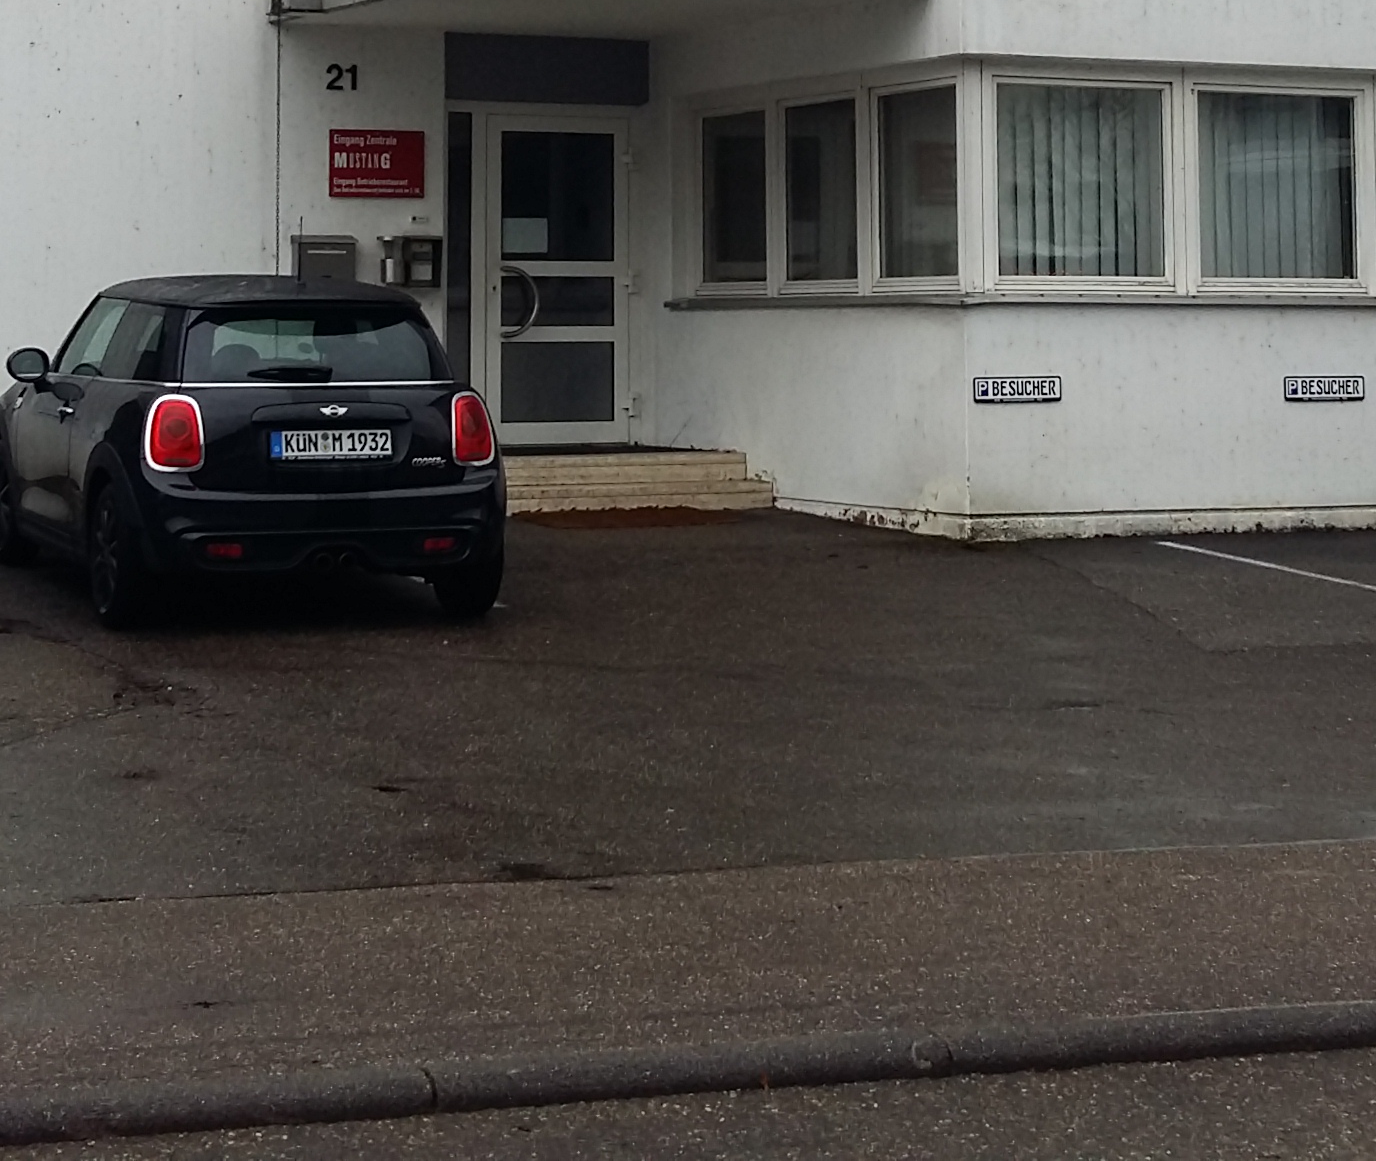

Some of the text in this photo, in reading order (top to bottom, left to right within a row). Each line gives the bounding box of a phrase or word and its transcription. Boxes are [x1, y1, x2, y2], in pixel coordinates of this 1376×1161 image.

[325, 63, 358, 90] 21
[333, 133, 397, 147] Eingang Zentrale
[992, 380, 1056, 397] BESUCHER
[1300, 379, 1360, 395] BESUCHER
[284, 432, 390, 453] KÜN M 1932
